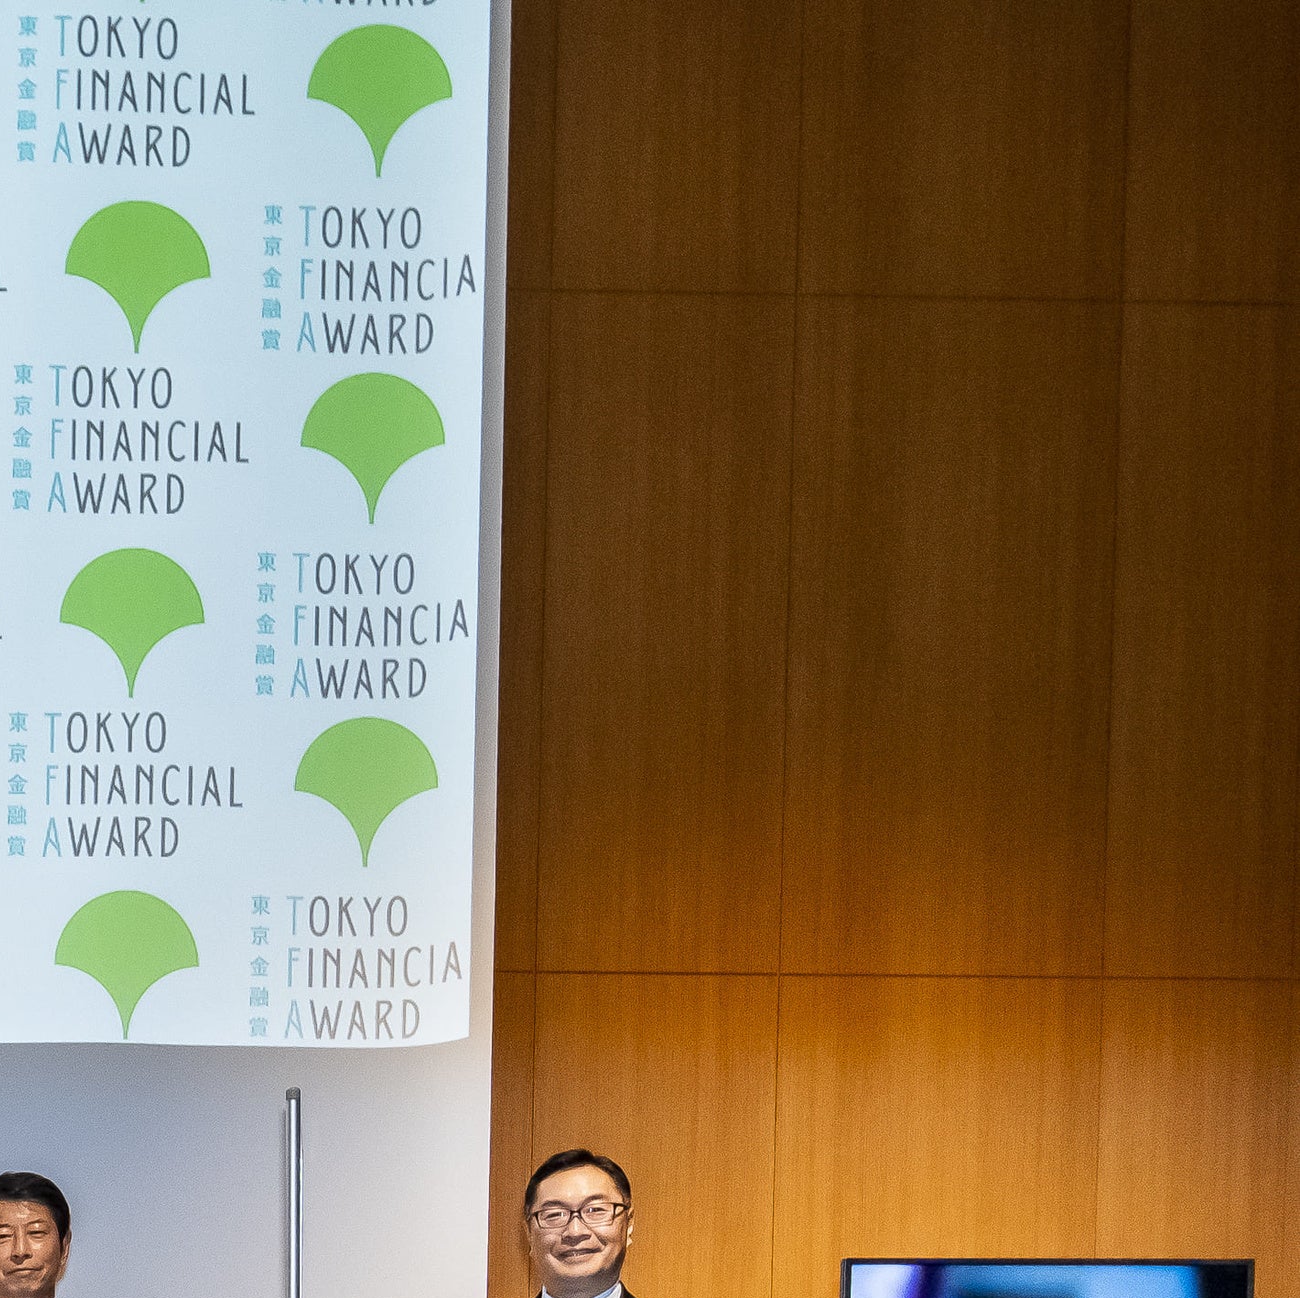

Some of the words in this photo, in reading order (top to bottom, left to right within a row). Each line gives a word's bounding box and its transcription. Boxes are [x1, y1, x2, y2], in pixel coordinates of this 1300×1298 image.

[54, 14, 178, 61] TOKYO
[17, 15, 39, 162] 東京金融賞
[56, 68, 256, 116] FINANCIAL
[52, 121, 191, 168] AWARD
[298, 205, 422, 250] TOKYO
[261, 204, 283, 351] 東京金融賞
[296, 311, 434, 355] AWARD
[48, 364, 172, 410] TOKYO
[12, 363, 33, 511] 東京金融賞
[51, 418, 249, 464] FINANCIAL
[47, 471, 185, 515] AWARD
[292, 552, 415, 596] TOKYO
[255, 551, 277, 696] 東京金融賞
[290, 657, 427, 700] AWARD
[44, 711, 167, 754] TOKYO
[7, 711, 28, 856] 東京金融賞
[46, 764, 243, 808] FINANCIAL
[42, 816, 179, 858] AWARD
[286, 895, 408, 937] TOKYO
[249, 894, 270, 1037] 東京金融賞
[284, 999, 420, 1040] AWARD
